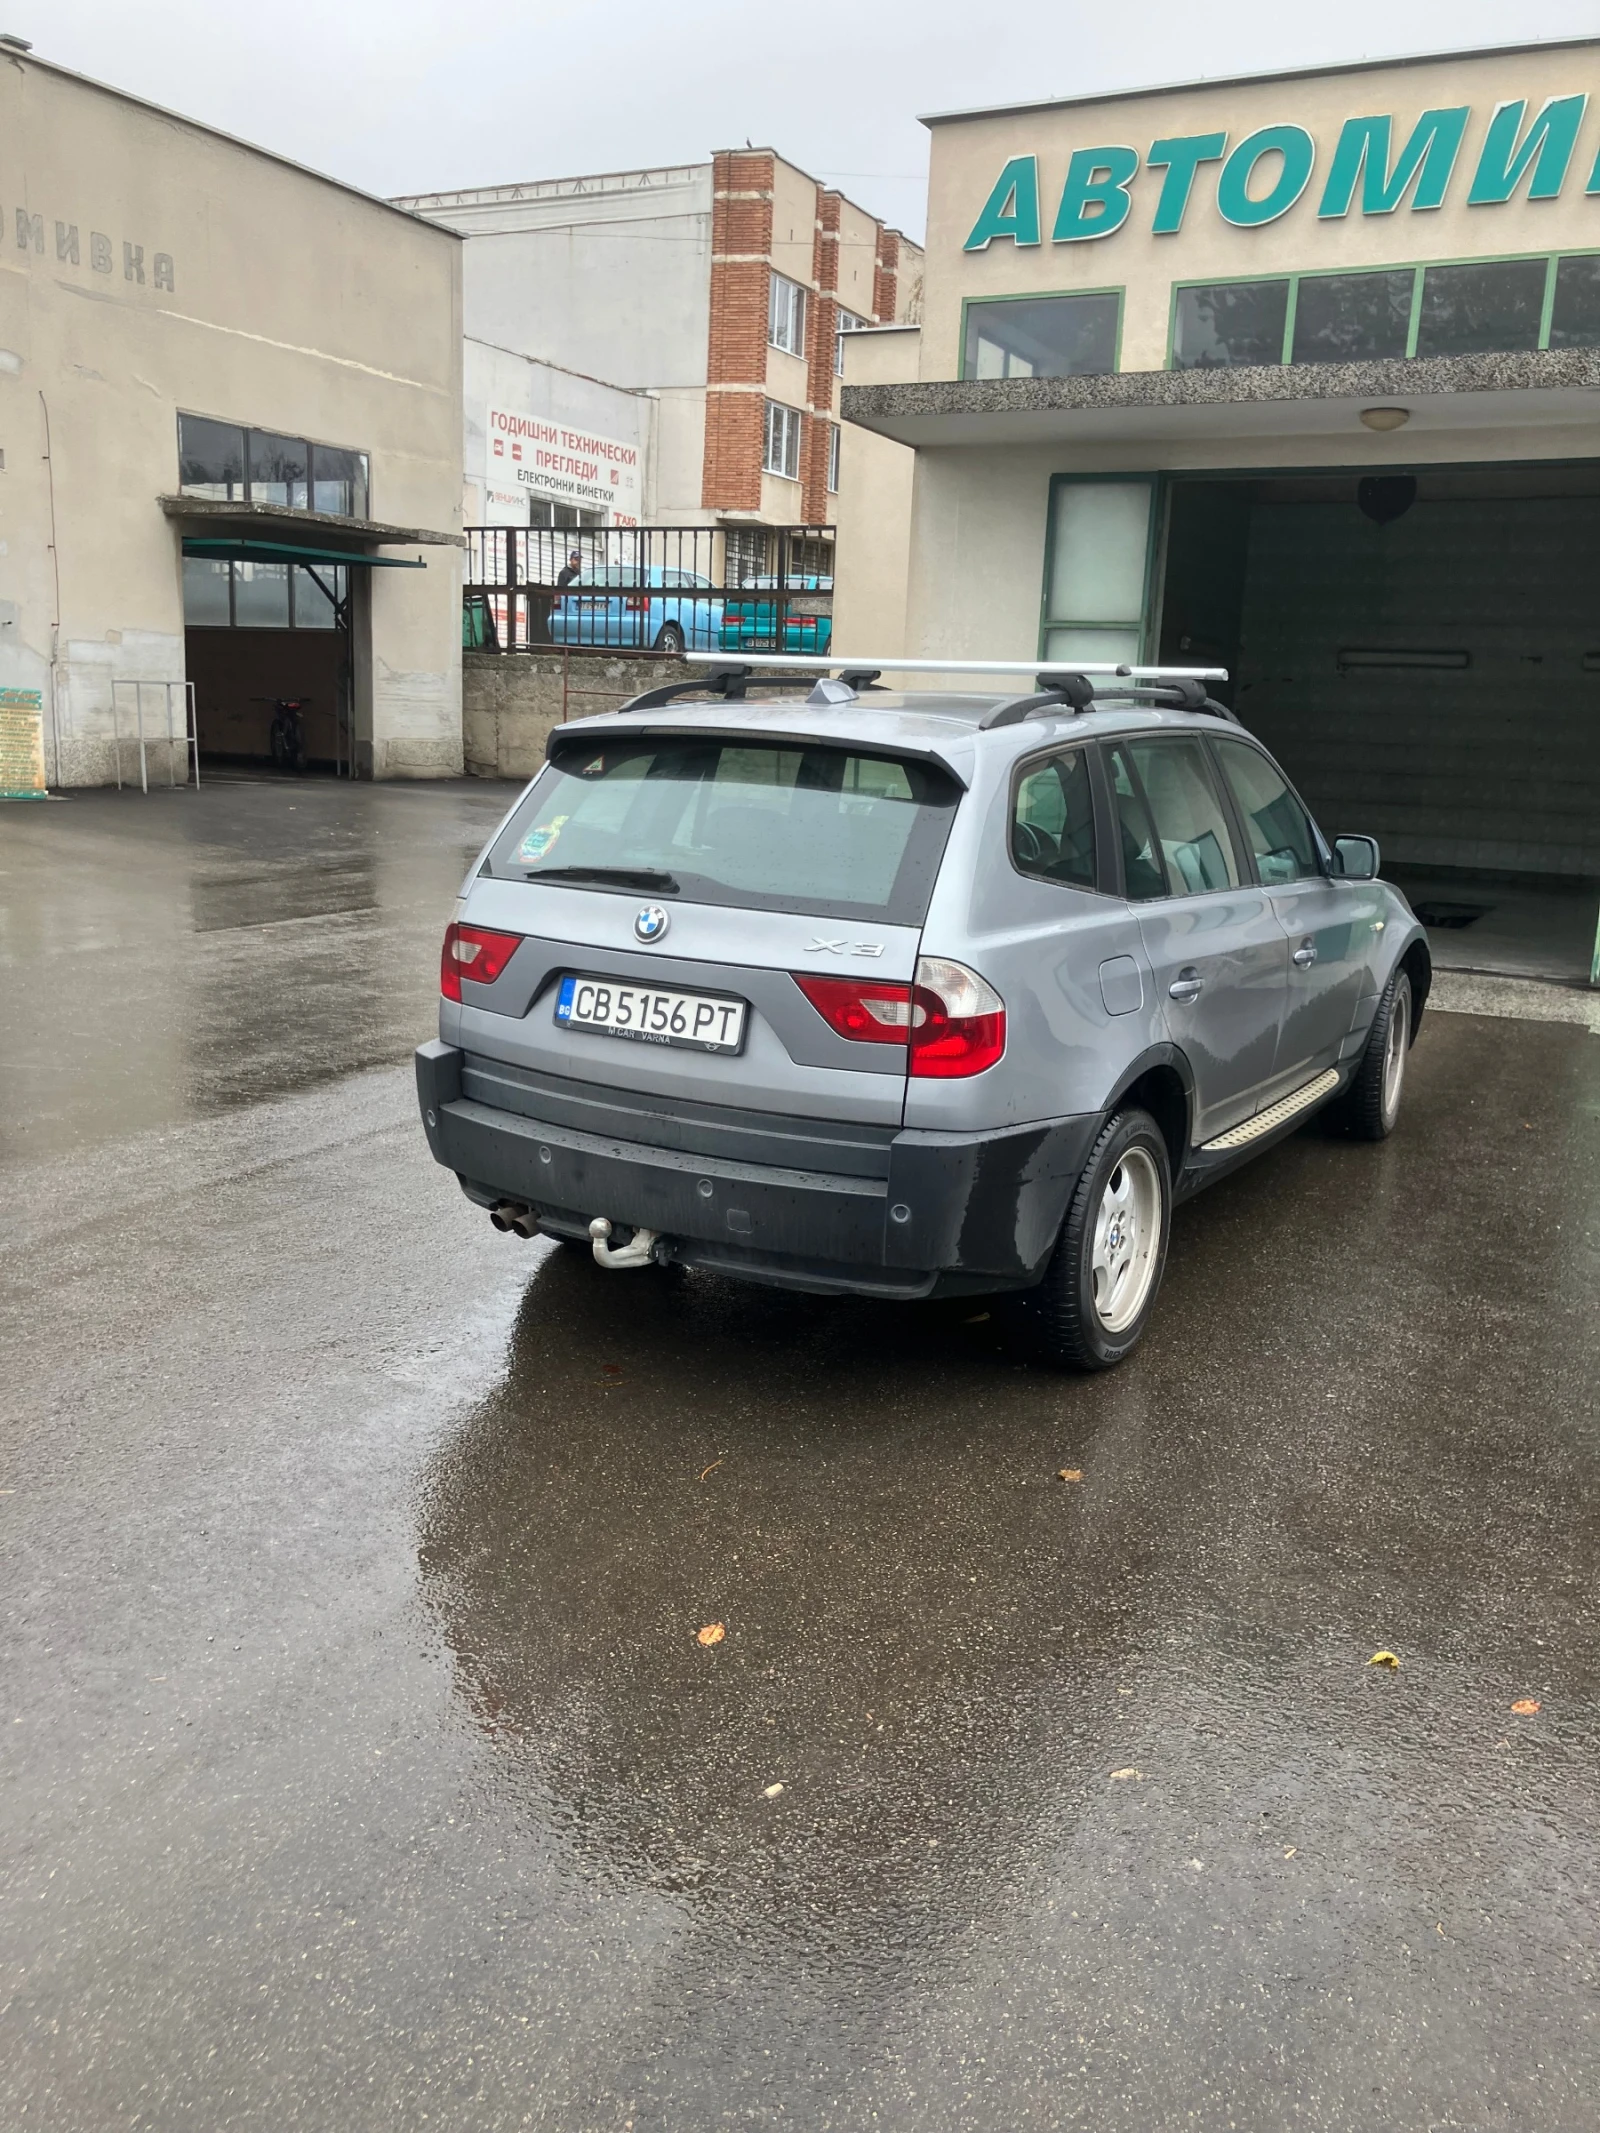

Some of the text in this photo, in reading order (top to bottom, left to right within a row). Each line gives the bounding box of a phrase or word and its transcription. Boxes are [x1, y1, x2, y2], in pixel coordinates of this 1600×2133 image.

[963, 92, 1600, 252] АВТОМИ
[0, 202, 175, 293] МИВКА
[491, 411, 636, 466] ГОДИШНИ ТЕХНИЧЕСКИ
[536, 450, 598, 482] ПРЕГЛЕДИ
[517, 469, 614, 502] ЕЛЕКТРОННИ ВИНЕТКИ
[558, 1004, 571, 1016] BG
[641, 1032, 671, 1044] VARNA
